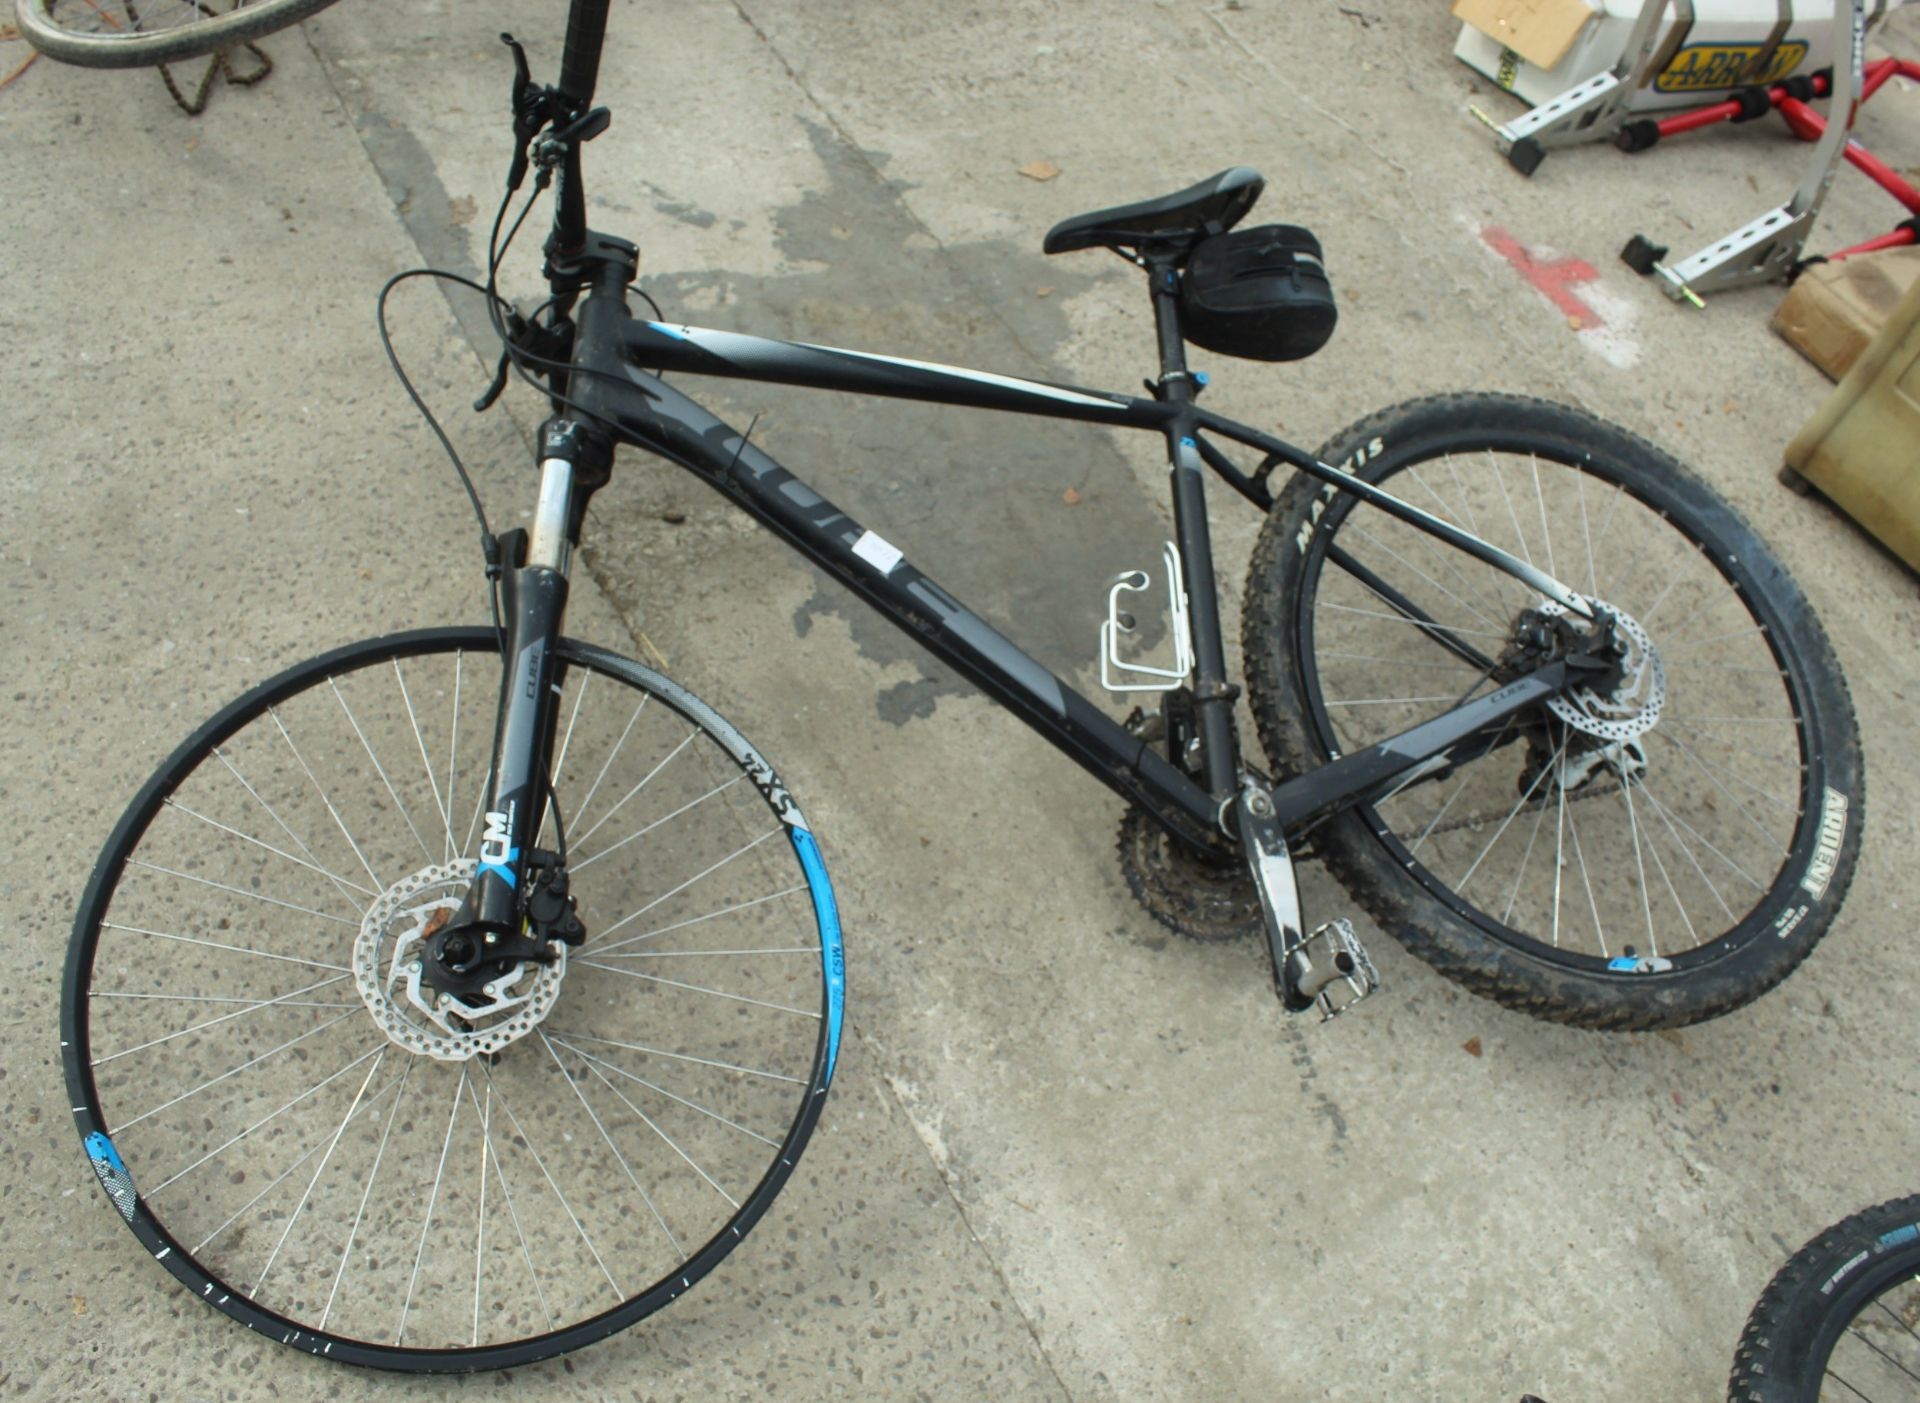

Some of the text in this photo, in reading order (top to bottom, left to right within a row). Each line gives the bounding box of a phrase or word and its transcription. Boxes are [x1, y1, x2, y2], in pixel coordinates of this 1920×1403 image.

[526, 646, 540, 700] CUBE
[1801, 787, 1848, 901] ARDENT
[831, 946, 843, 976] CSW
